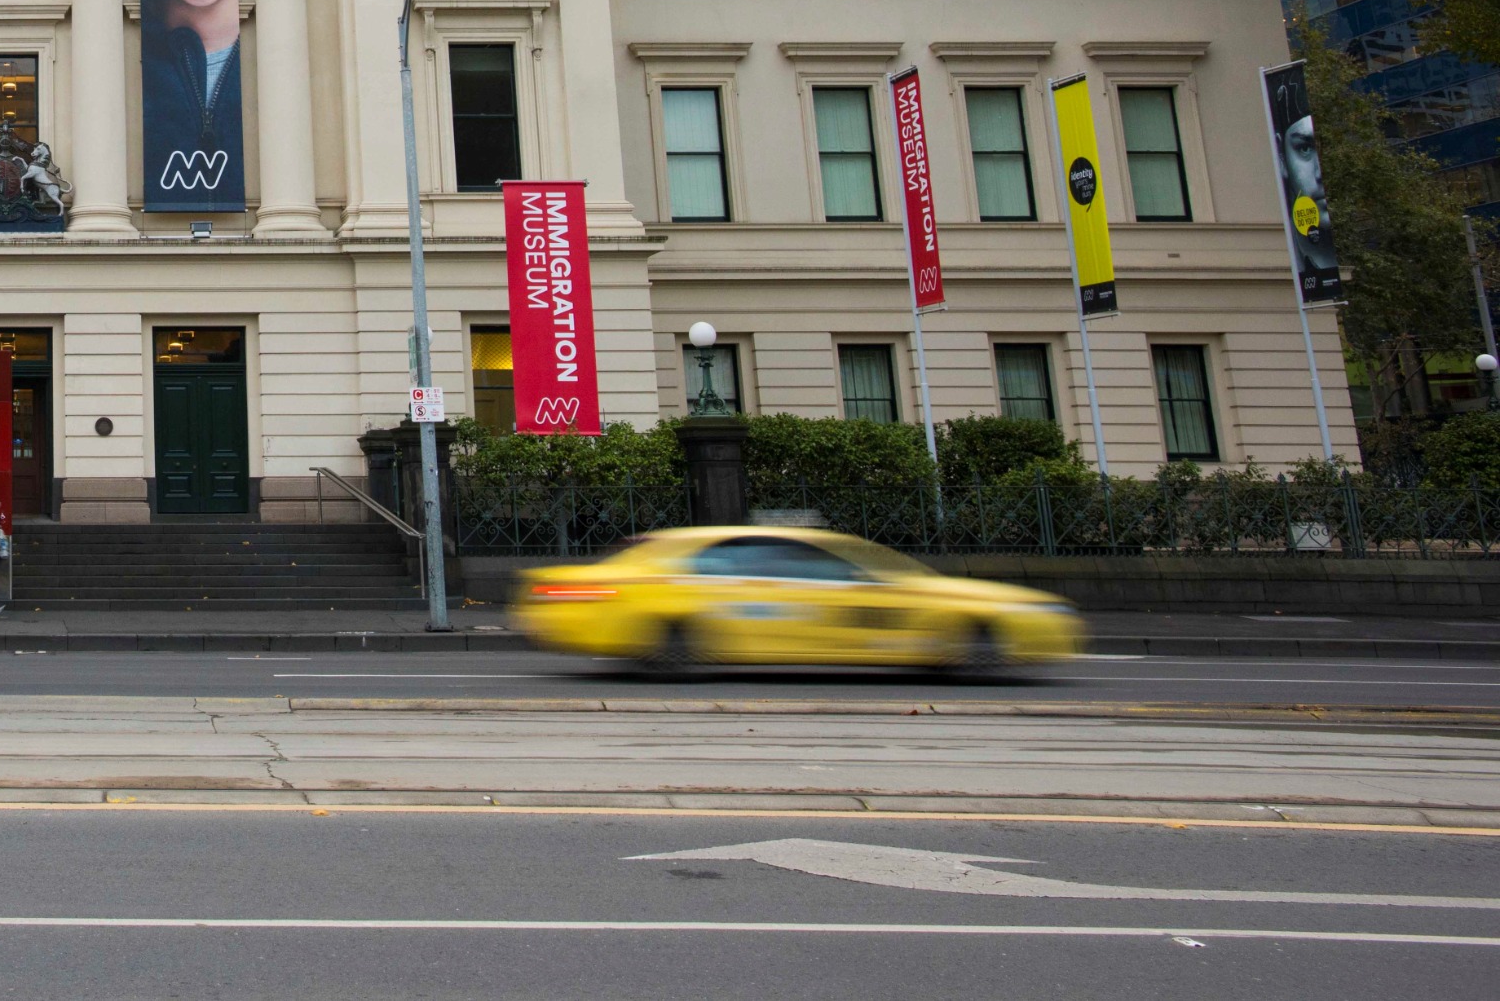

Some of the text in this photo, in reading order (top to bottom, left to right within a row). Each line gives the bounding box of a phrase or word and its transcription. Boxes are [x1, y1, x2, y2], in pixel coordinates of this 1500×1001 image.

[897, 86, 918, 191] MUSEUM
[907, 82, 935, 252] IMMIGRATION
[1070, 168, 1093, 181] identity
[521, 192, 549, 309] MUSEUM
[545, 192, 579, 382] IMMIGRATION
